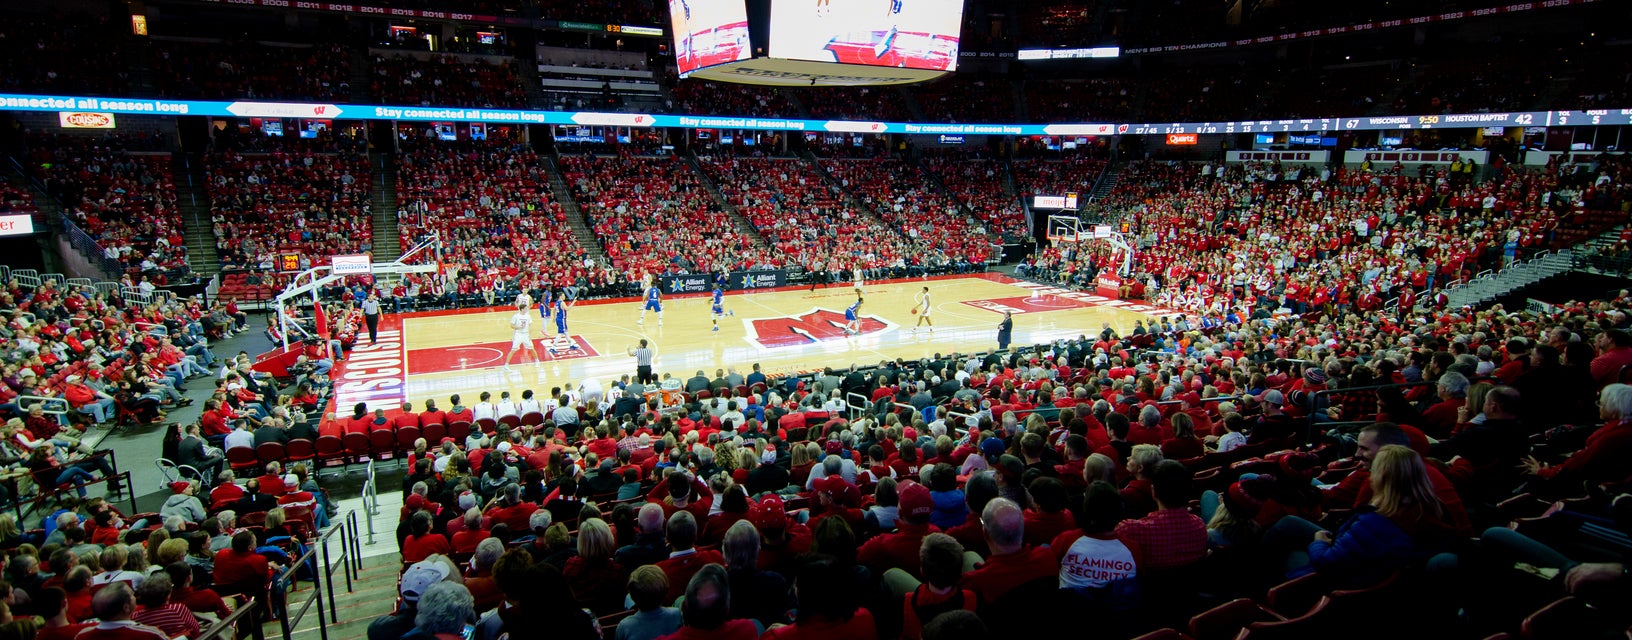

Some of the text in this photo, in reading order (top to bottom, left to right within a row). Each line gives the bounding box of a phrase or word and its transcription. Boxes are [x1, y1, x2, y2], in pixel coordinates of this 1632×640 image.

[391, 8, 415, 16] 2015
[422, 11, 445, 19] 2016
[1303, 29, 1321, 37] 1913
[1327, 26, 1345, 34] 1914
[1409, 15, 1431, 24] 1921
[1439, 11, 1464, 20] 1923
[1471, 7, 1497, 17] 1924
[1505, 3, 1533, 12] 1929
[606, 24, 621, 32] 8:30
[1180, 41, 1228, 50] CHAMPIONS
[78, 98, 98, 110] all
[100, 101, 153, 111] season
[156, 102, 188, 114] long
[68, 114, 108, 125] COUSINS
[375, 107, 545, 122] Stay connected all season long
[1419, 115, 1439, 124] 9:50
[1445, 113, 1510, 123] HOUSTON BAPTIST
[1514, 114, 1533, 125] 42
[680, 117, 805, 129] Stay connected all season long
[1346, 120, 1360, 129] 67
[1369, 117, 1409, 125] WISCONSIN
[1558, 117, 1567, 125] 3
[1592, 116, 1600, 124] 5
[905, 124, 921, 133] Stay
[922, 124, 963, 133] connected
[1003, 125, 1022, 134] long
[1169, 135, 1195, 144] Quartz
[1068, 553, 1133, 572] FLAMINGO
[1069, 564, 1129, 581] SECURITY
